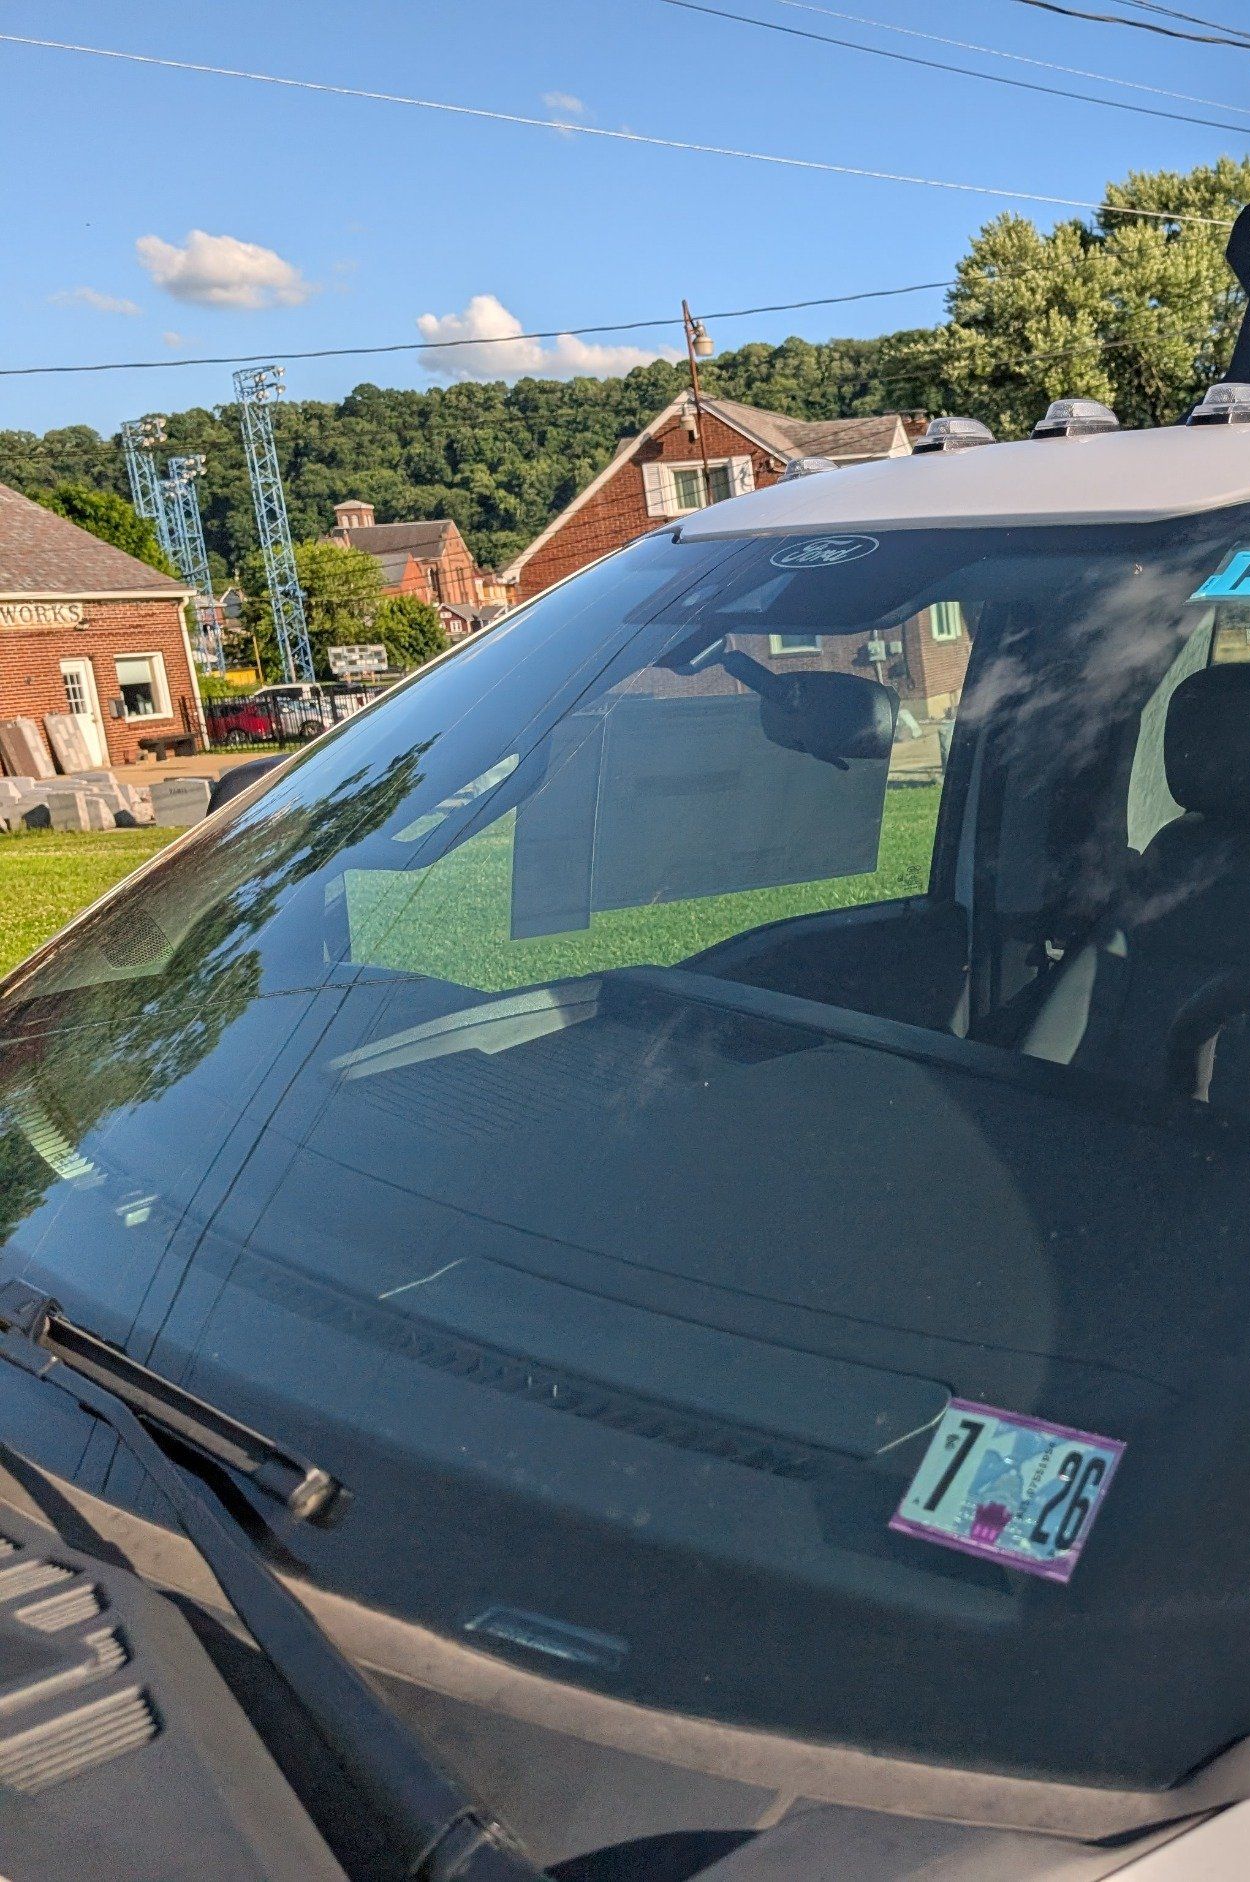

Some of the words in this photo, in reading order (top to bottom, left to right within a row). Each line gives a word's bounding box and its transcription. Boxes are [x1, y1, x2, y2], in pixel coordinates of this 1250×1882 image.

[780, 538, 866, 564] Ford
[0, 604, 80, 624] WORKS
[922, 1418, 986, 1512] 7
[1029, 1450, 1107, 1550] 26
